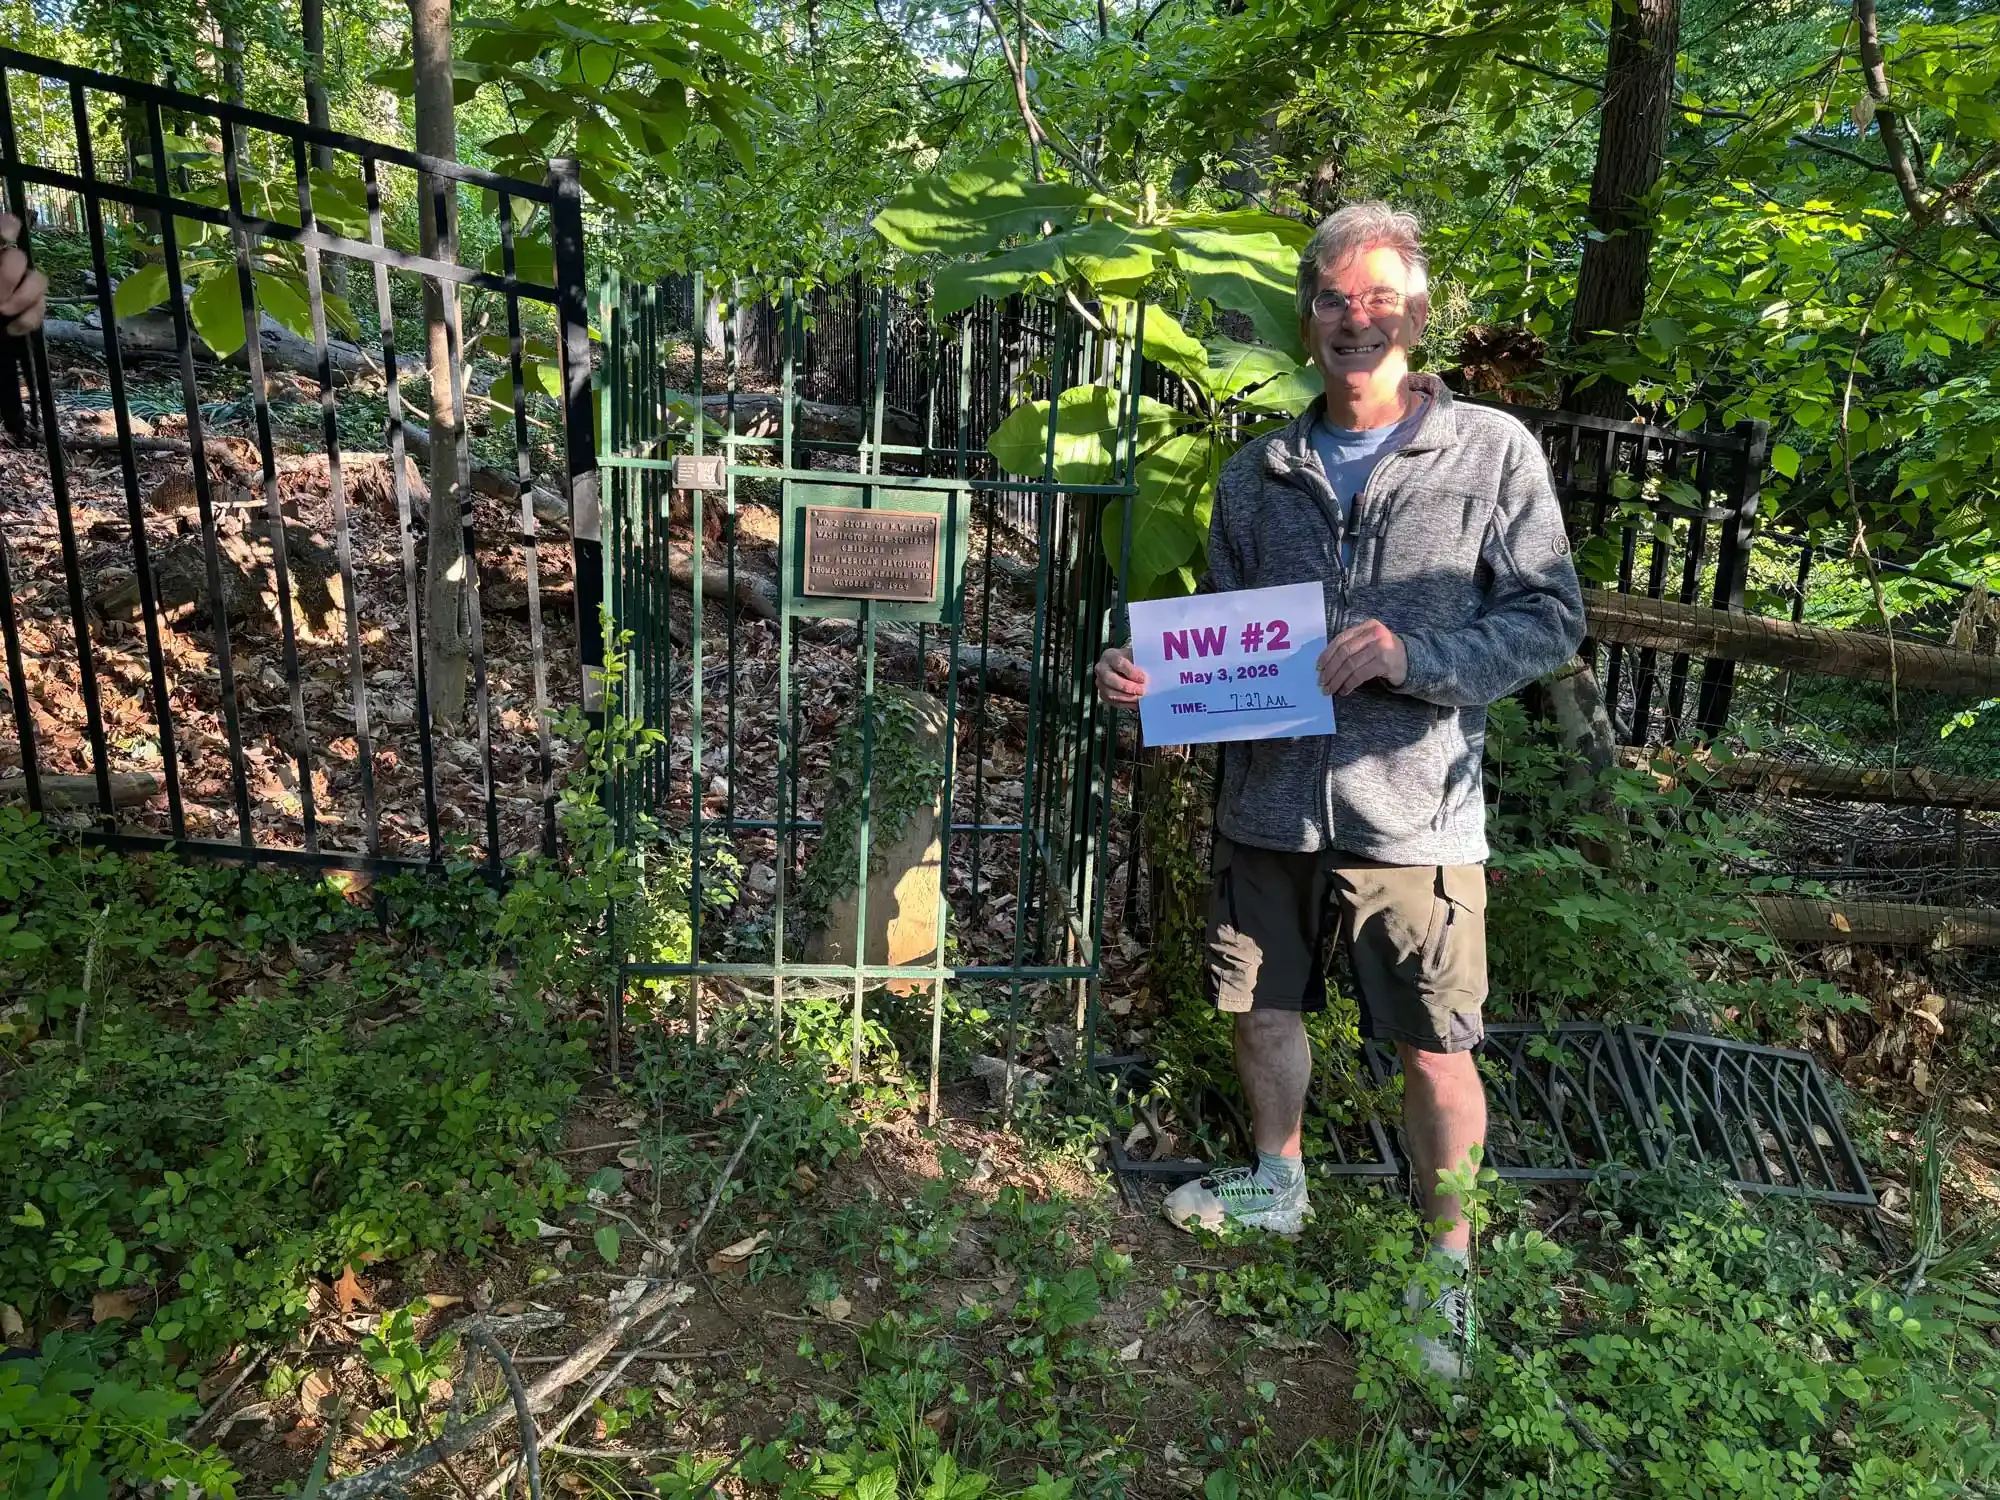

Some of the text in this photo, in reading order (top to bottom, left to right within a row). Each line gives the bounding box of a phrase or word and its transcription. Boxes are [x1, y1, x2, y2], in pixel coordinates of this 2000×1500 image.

[841, 544, 885, 554] CHILDREN
[834, 556, 877, 567] AMERICAN
[882, 559, 931, 569] REVOLUTION
[810, 566, 840, 576] THOMAS
[833, 578, 870, 588] OCTOBER
[1163, 620, 1291, 660] NW #2
[1179, 663, 1279, 685] May 3, 2026
[1230, 692, 1260, 711] 7:27
[1171, 702, 1208, 714] TIME:
